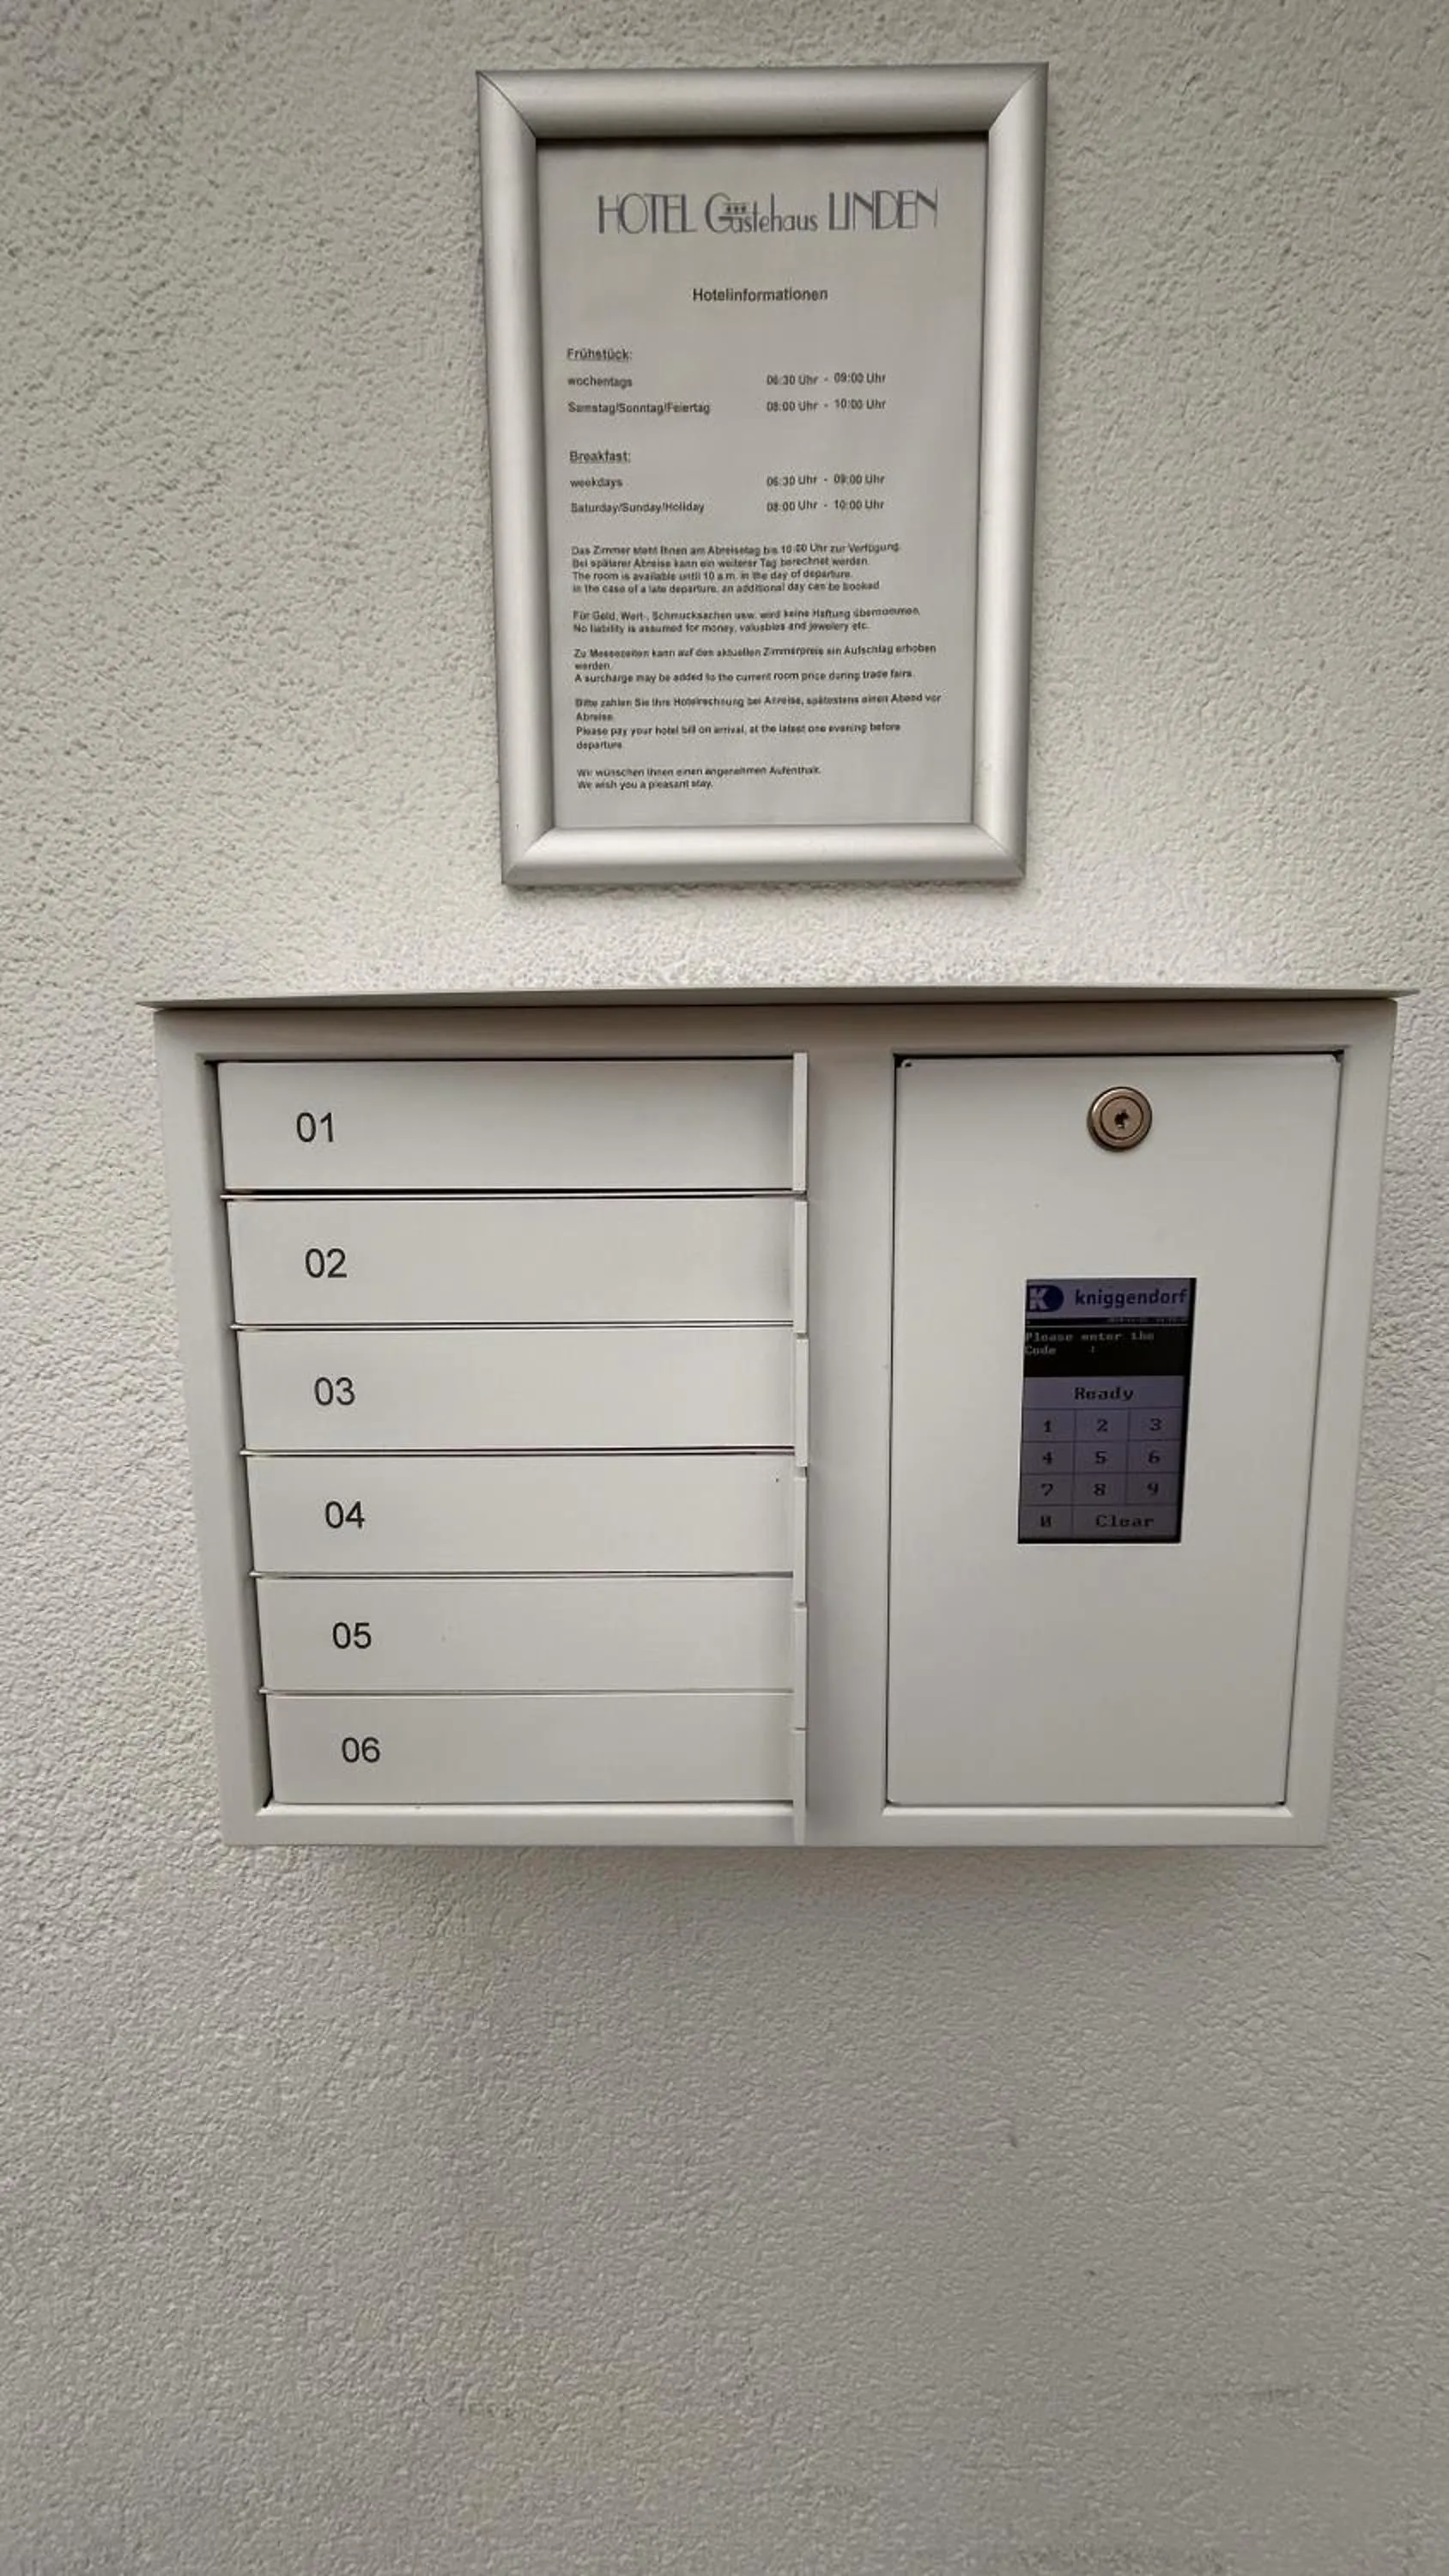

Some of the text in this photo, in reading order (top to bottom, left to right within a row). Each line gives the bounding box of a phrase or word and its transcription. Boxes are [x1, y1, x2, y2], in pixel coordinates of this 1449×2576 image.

[598, 192, 697, 235] HOTEL
[828, 185, 939, 231] LINDEN
[692, 288, 828, 302] Hotelinformationen
[567, 348, 633, 362] Frühstück:
[567, 375, 633, 390] wochentags
[797, 374, 819, 386] Uhr
[834, 371, 864, 384] 09:00
[866, 371, 887, 384] Uhr
[767, 400, 796, 412] 08:00
[797, 400, 819, 411] Uhr
[834, 398, 864, 410] 10:00
[866, 398, 887, 410] Uhr
[569, 450, 632, 465] Breakfast:
[570, 477, 624, 489] weekdays
[797, 474, 818, 485] Uhr
[865, 473, 886, 485] Uhr
[797, 499, 818, 511] Uhr
[834, 499, 863, 511] 10:00
[865, 499, 885, 510] Uhr
[296, 1112, 335, 1142] 01
[305, 1248, 348, 1279] 02
[1076, 1289, 1189, 1309] kniggendorf
[1026, 1332, 1074, 1343] Please
[1081, 1332, 1123, 1341] enter
[314, 1376, 355, 1406] 03
[1074, 1386, 1134, 1402] Ready
[1043, 1418, 1162, 1433] 1 2 3
[1042, 1450, 1161, 1465] 4 5 6
[1041, 1482, 1159, 1497] 7 8 9
[324, 1501, 366, 1529] 04
[1095, 1514, 1155, 1528] Clear
[331, 1622, 373, 1649] 05
[342, 1737, 381, 1764] 06
